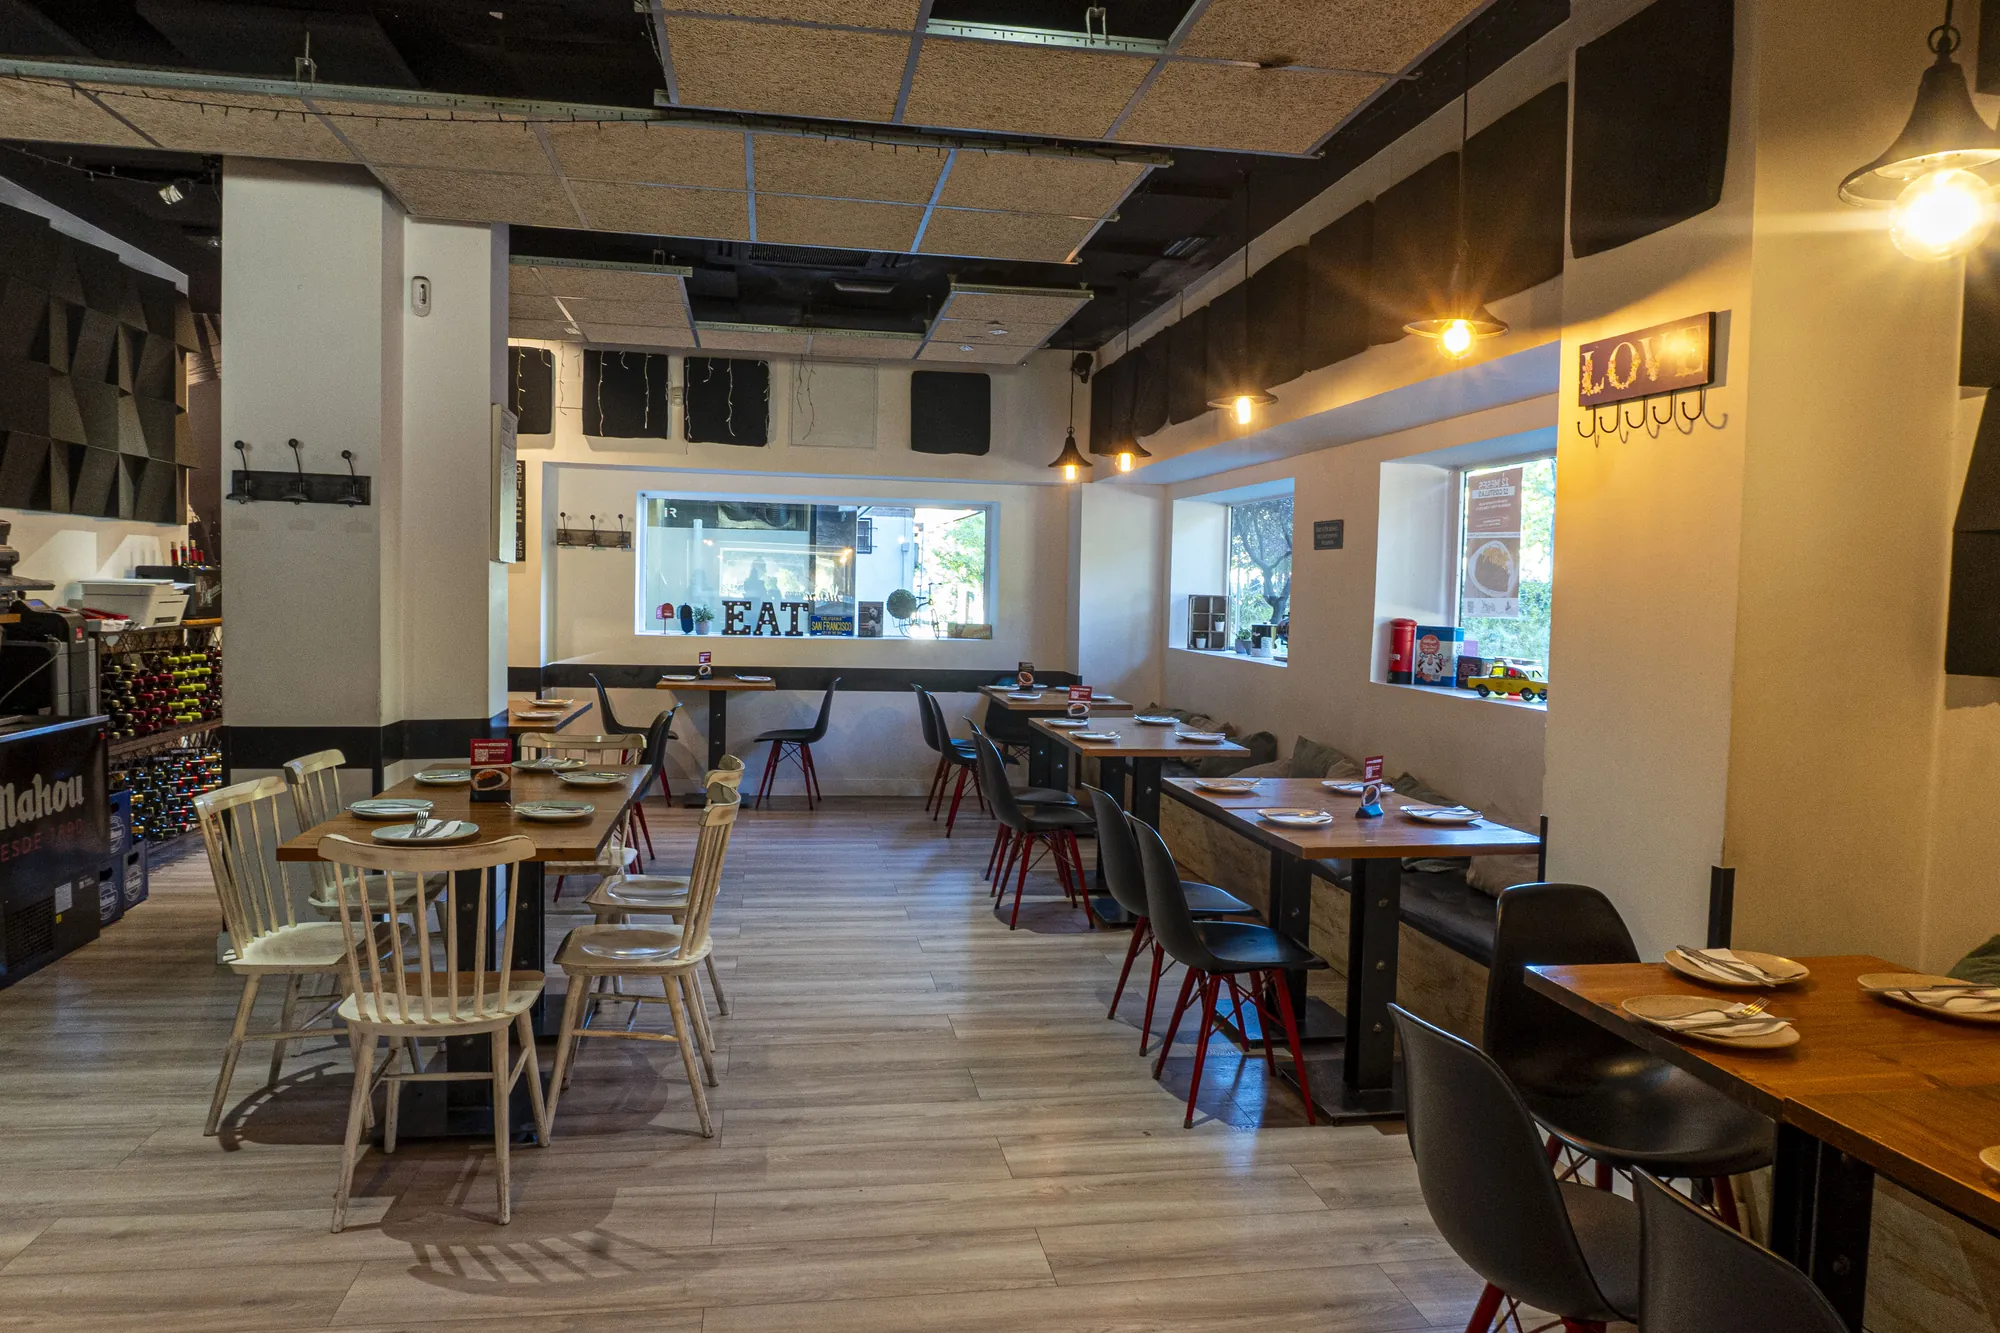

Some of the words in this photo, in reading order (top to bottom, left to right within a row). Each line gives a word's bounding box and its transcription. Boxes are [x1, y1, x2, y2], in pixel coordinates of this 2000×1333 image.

[722, 600, 808, 636] EAT
[812, 621, 822, 631] SAN
[823, 621, 852, 631] FRANCISCO
